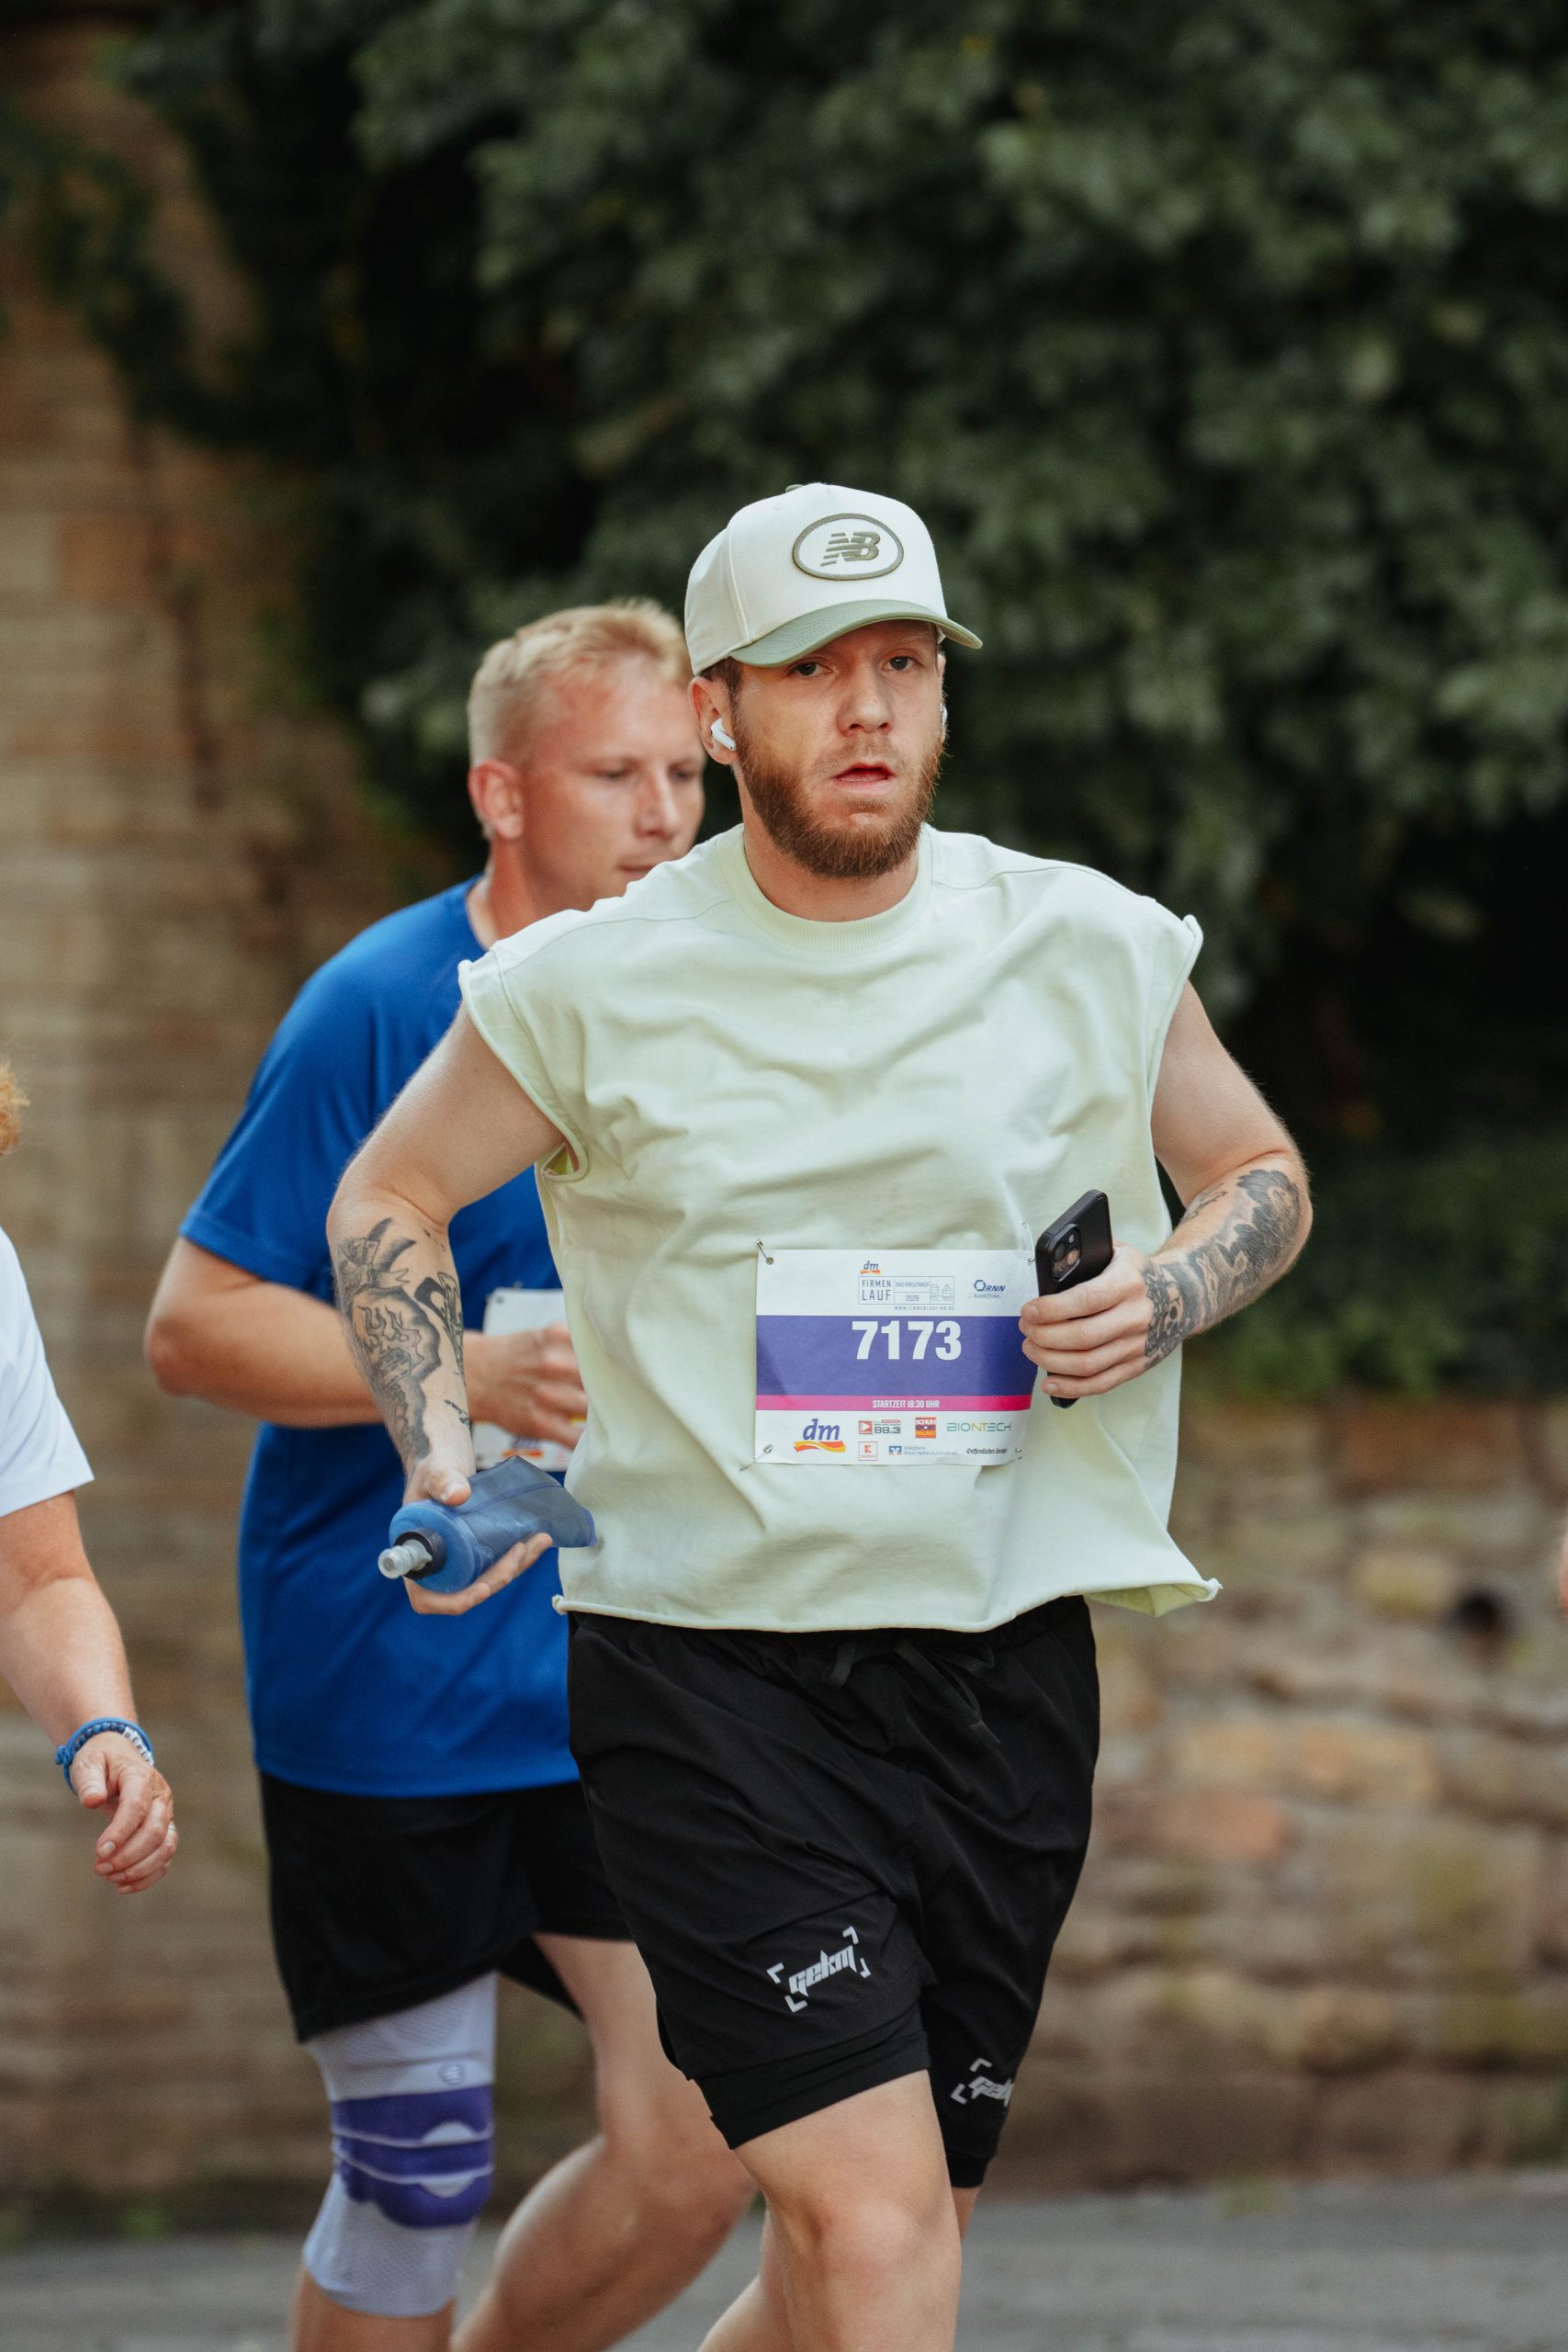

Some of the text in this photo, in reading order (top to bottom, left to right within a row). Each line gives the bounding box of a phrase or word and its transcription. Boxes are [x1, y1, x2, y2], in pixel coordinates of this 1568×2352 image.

[863, 1261, 879, 1271] dm
[862, 1279, 892, 1288] FIRMEN
[862, 1289, 892, 1301] LAUF
[852, 1319, 962, 1361] 7173
[873, 1399, 941, 1408] STARTZEIT 18:30 UHR
[802, 1418, 840, 1441] dm
[874, 1426, 901, 1434] 88.3
[946, 1422, 1011, 1432] BIONTECH
